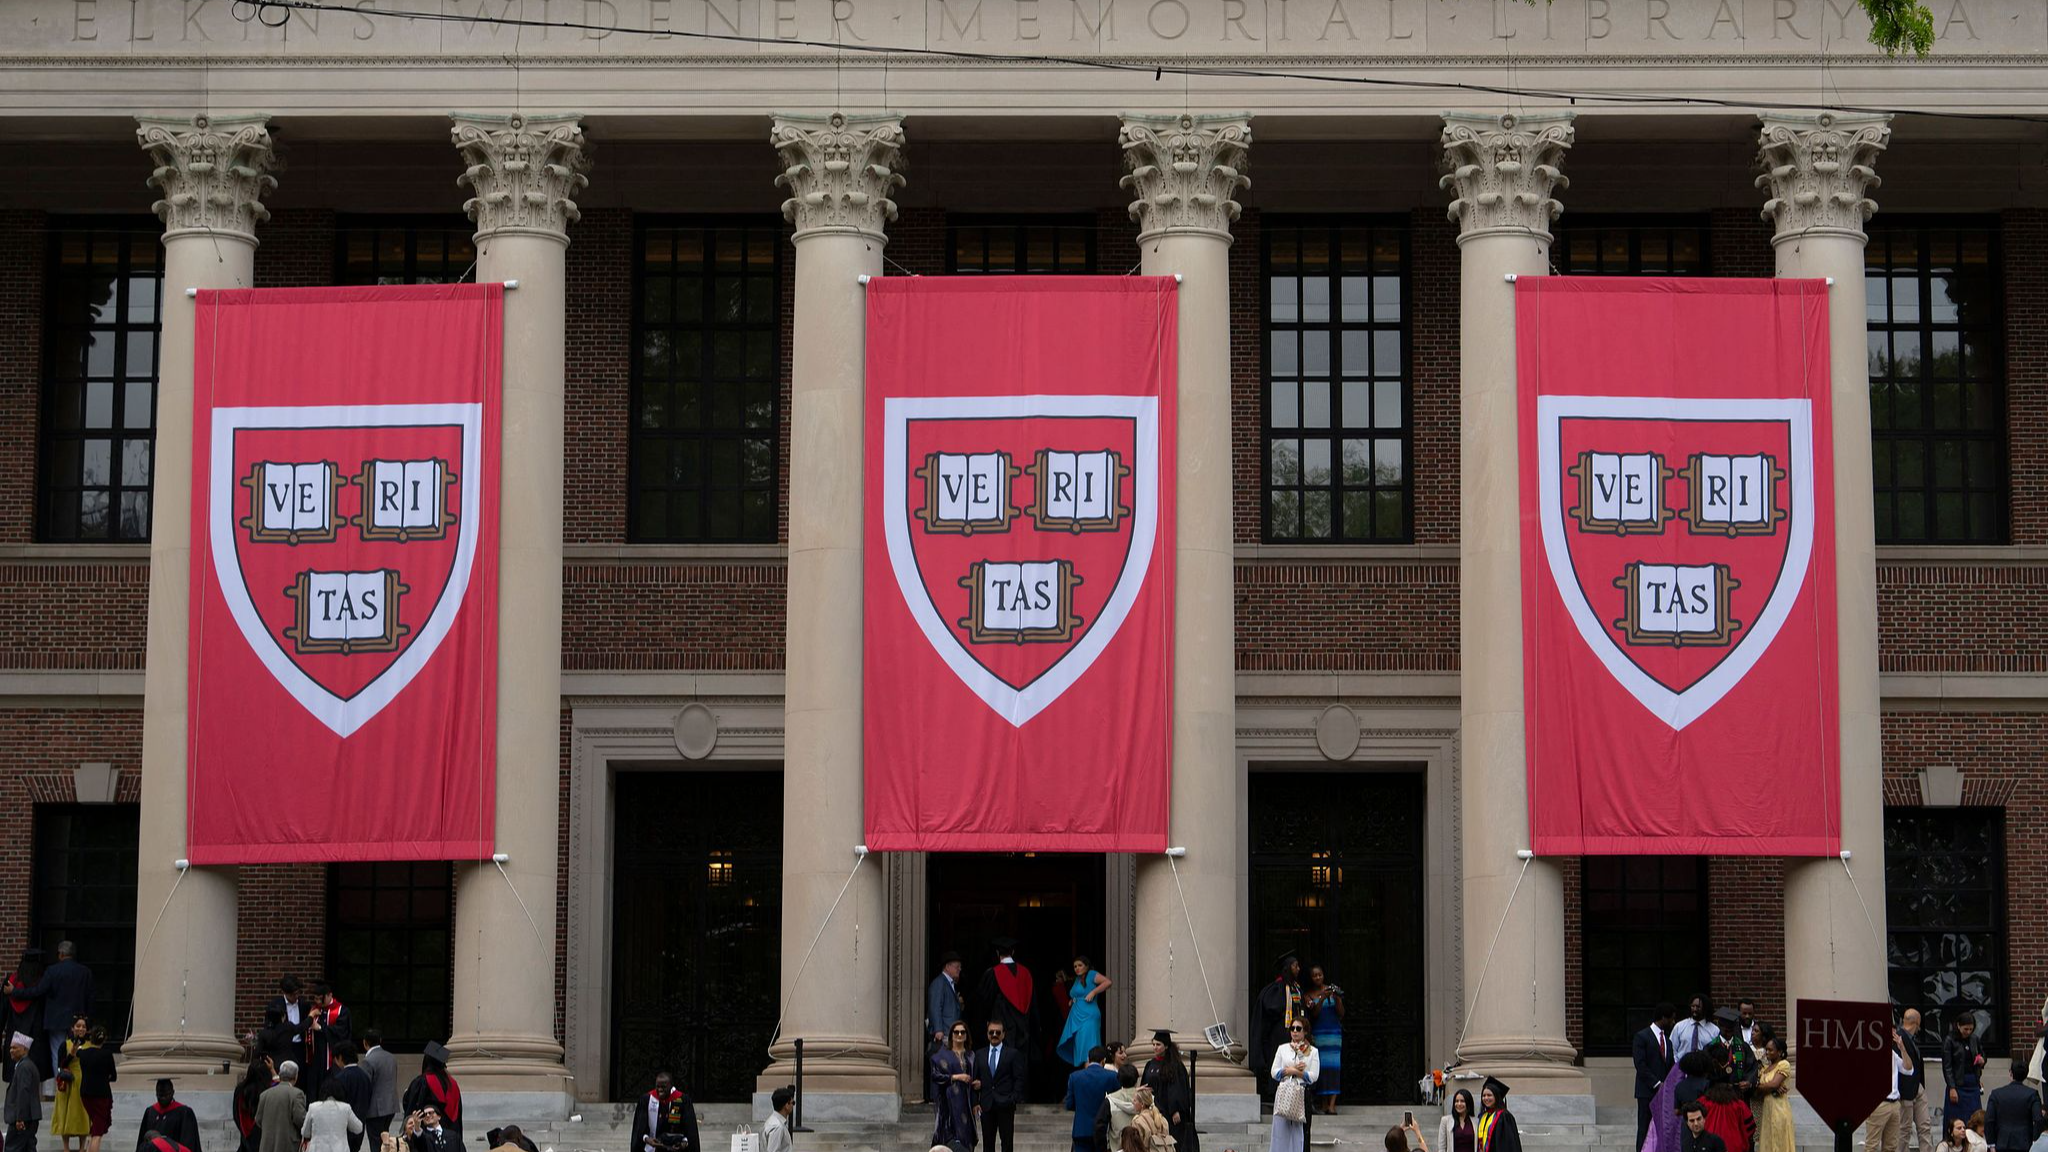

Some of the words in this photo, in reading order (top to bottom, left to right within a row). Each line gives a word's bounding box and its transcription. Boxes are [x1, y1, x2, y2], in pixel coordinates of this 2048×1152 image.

[70, 0, 377, 42] ELKINS
[449, 0, 867, 42] WIDENER
[936, 0, 1414, 42] MEMORIAL
[1488, 0, 1861, 41] LIBRARY
[267, 483, 316, 513] VE
[379, 480, 421, 511] RI
[941, 473, 990, 504] VE
[1053, 471, 1094, 502] RI
[1594, 473, 1643, 504] VE
[1707, 475, 1749, 506] RI
[317, 589, 378, 621] TAS
[992, 579, 1051, 611] TAS
[1646, 581, 1709, 614] TAS
[1802, 1017, 1884, 1051] HMS
